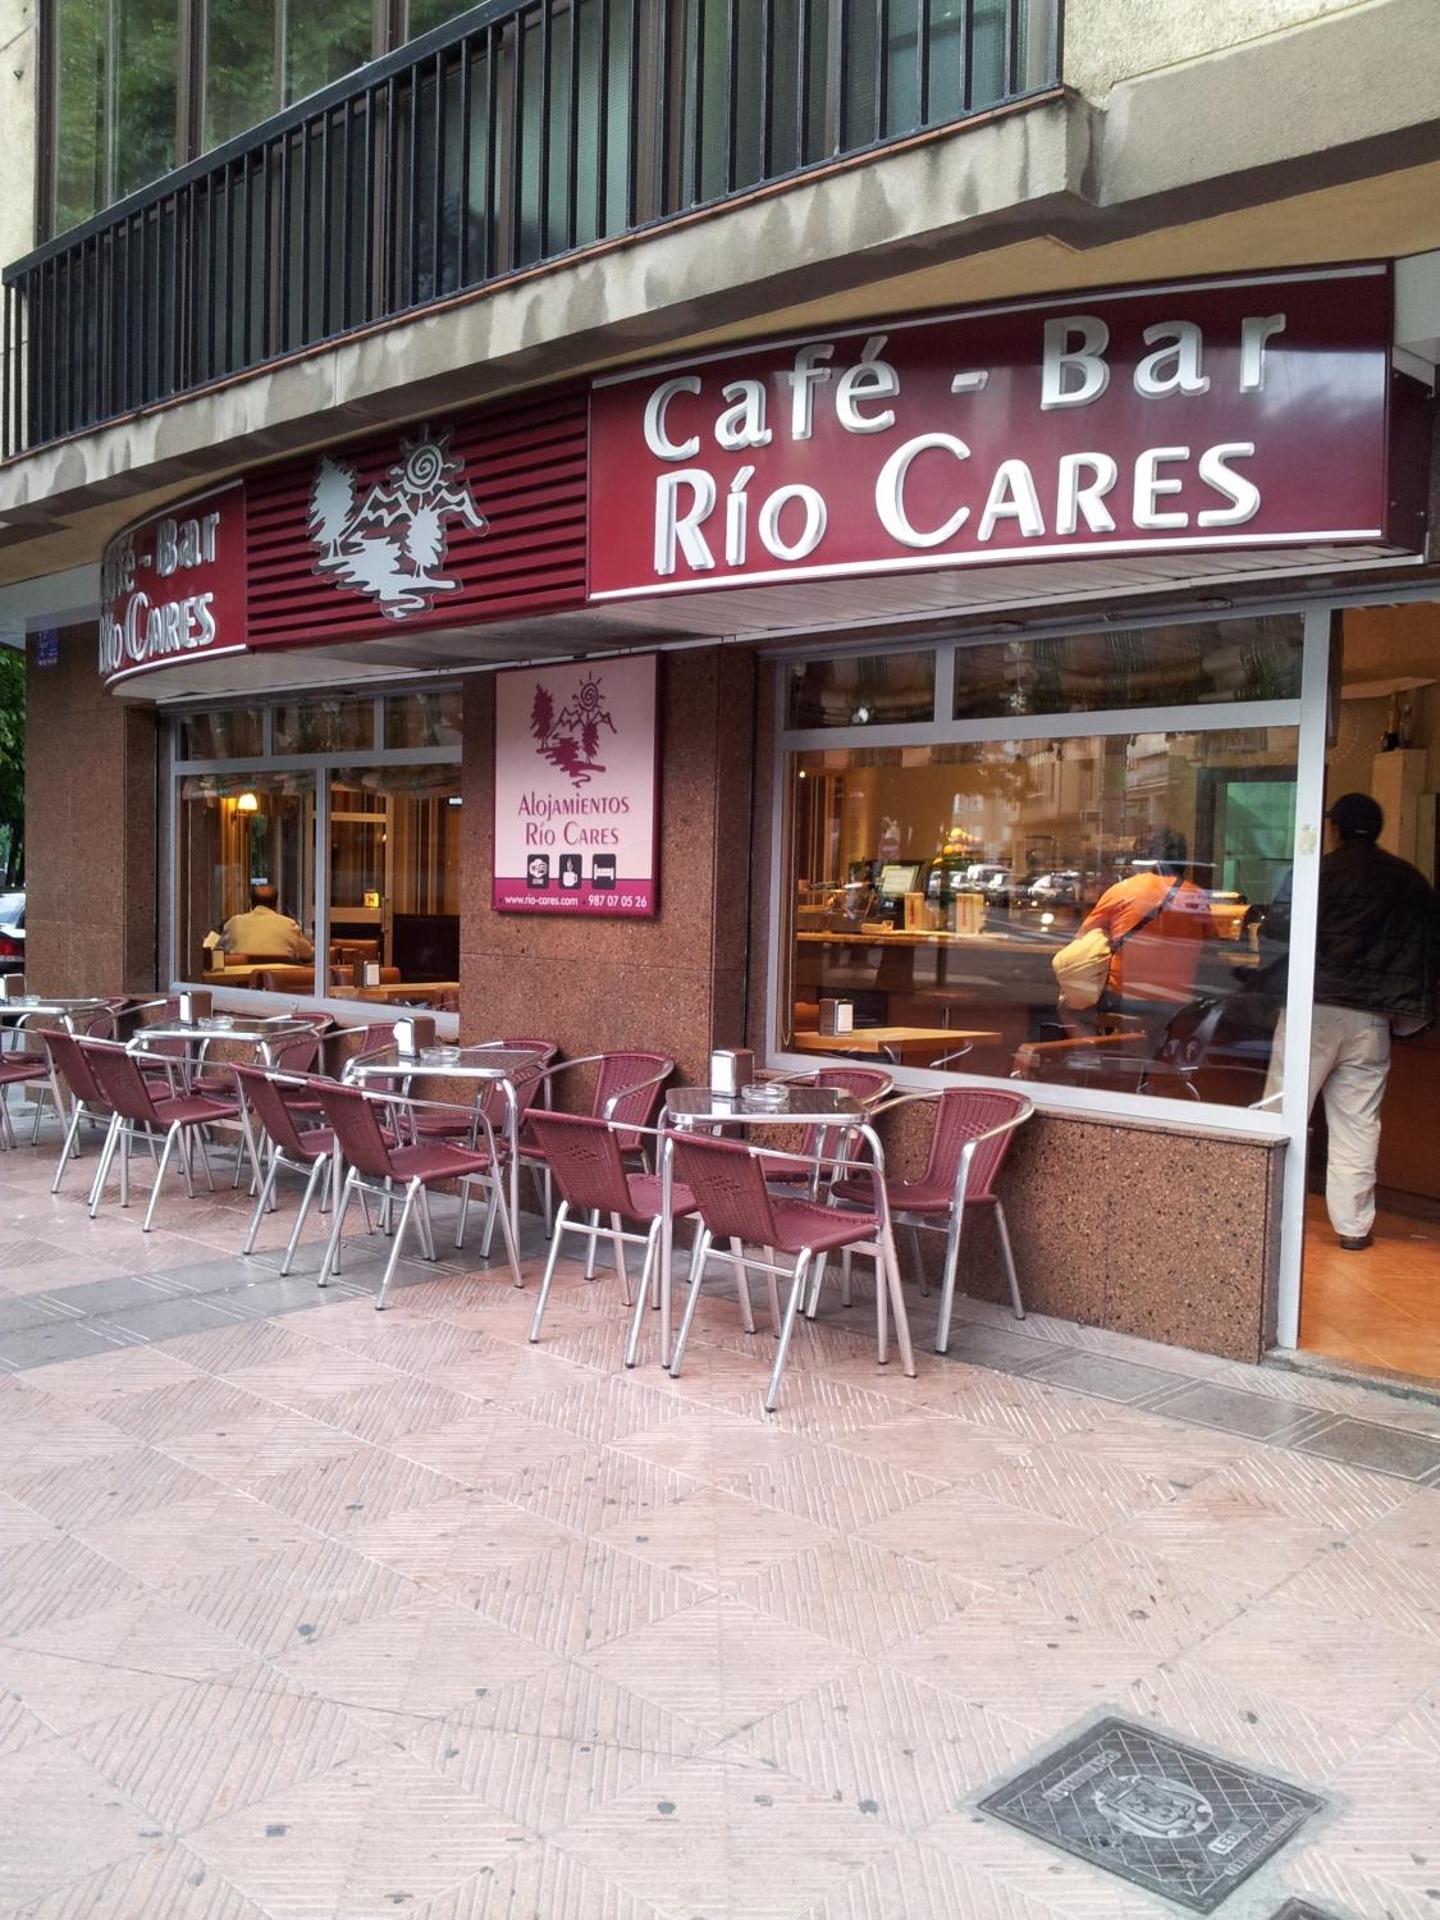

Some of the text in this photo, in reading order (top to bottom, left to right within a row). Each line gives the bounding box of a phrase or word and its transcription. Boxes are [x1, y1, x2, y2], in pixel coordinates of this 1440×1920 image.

[644, 336, 900, 461] Café
[1041, 313, 1286, 411] Bar
[654, 432, 1261, 576] Río CARES
[156, 512, 220, 578] Bar
[526, 821, 555, 846] Río
[588, 895, 605, 906] 987
[607, 895, 619, 906] 07
[621, 896, 633, 907] 05
[635, 896, 647, 908] 26
